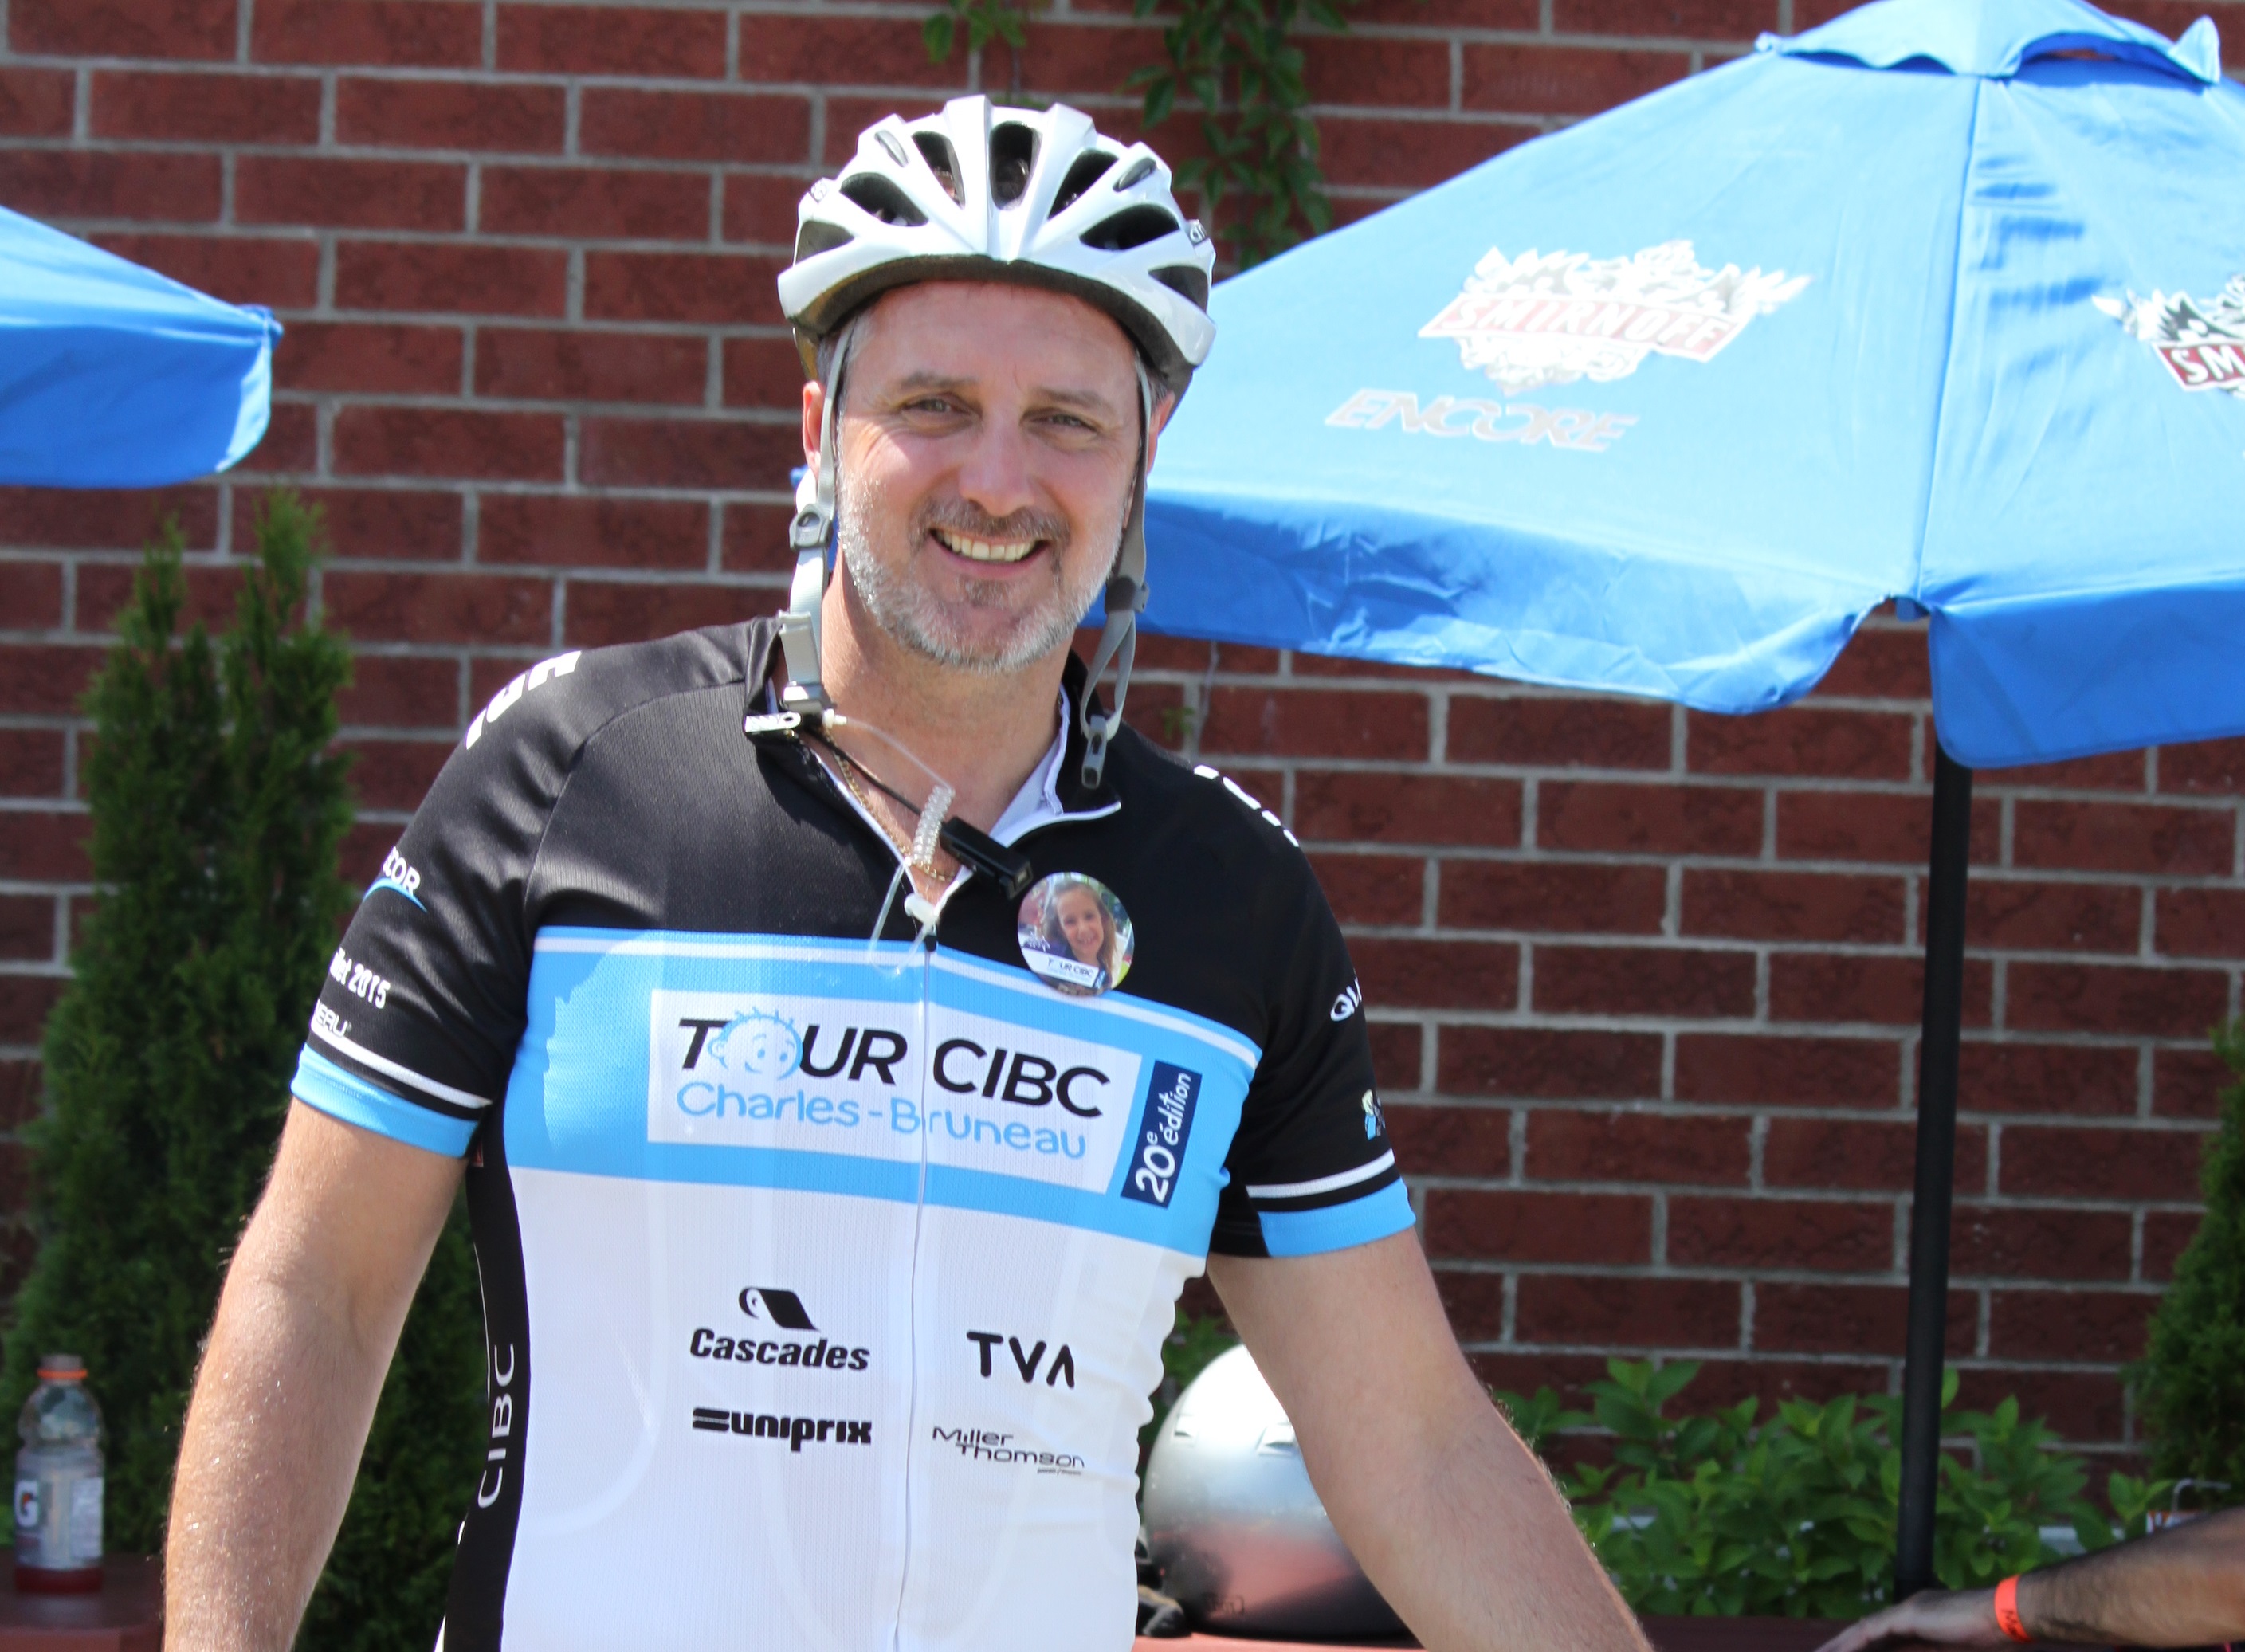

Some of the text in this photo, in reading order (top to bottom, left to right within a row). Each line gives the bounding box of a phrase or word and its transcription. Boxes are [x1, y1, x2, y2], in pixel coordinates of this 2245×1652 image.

[1441, 298, 1733, 349] SMIRNOFF
[2169, 343, 2245, 384] SM
[1324, 387, 1641, 453] ENCORE
[347, 963, 391, 1010] 2015
[932, 1038, 1111, 1119] CIBC
[1157, 1072, 1192, 1147] édition
[689, 1327, 871, 1372] Cascades
[966, 1330, 1076, 1390] TVA
[477, 1343, 516, 1509] CIBC
[730, 1411, 873, 1454] uniprix
[932, 1425, 1015, 1447] Miller
[955, 1441, 1085, 1470] Thomson
